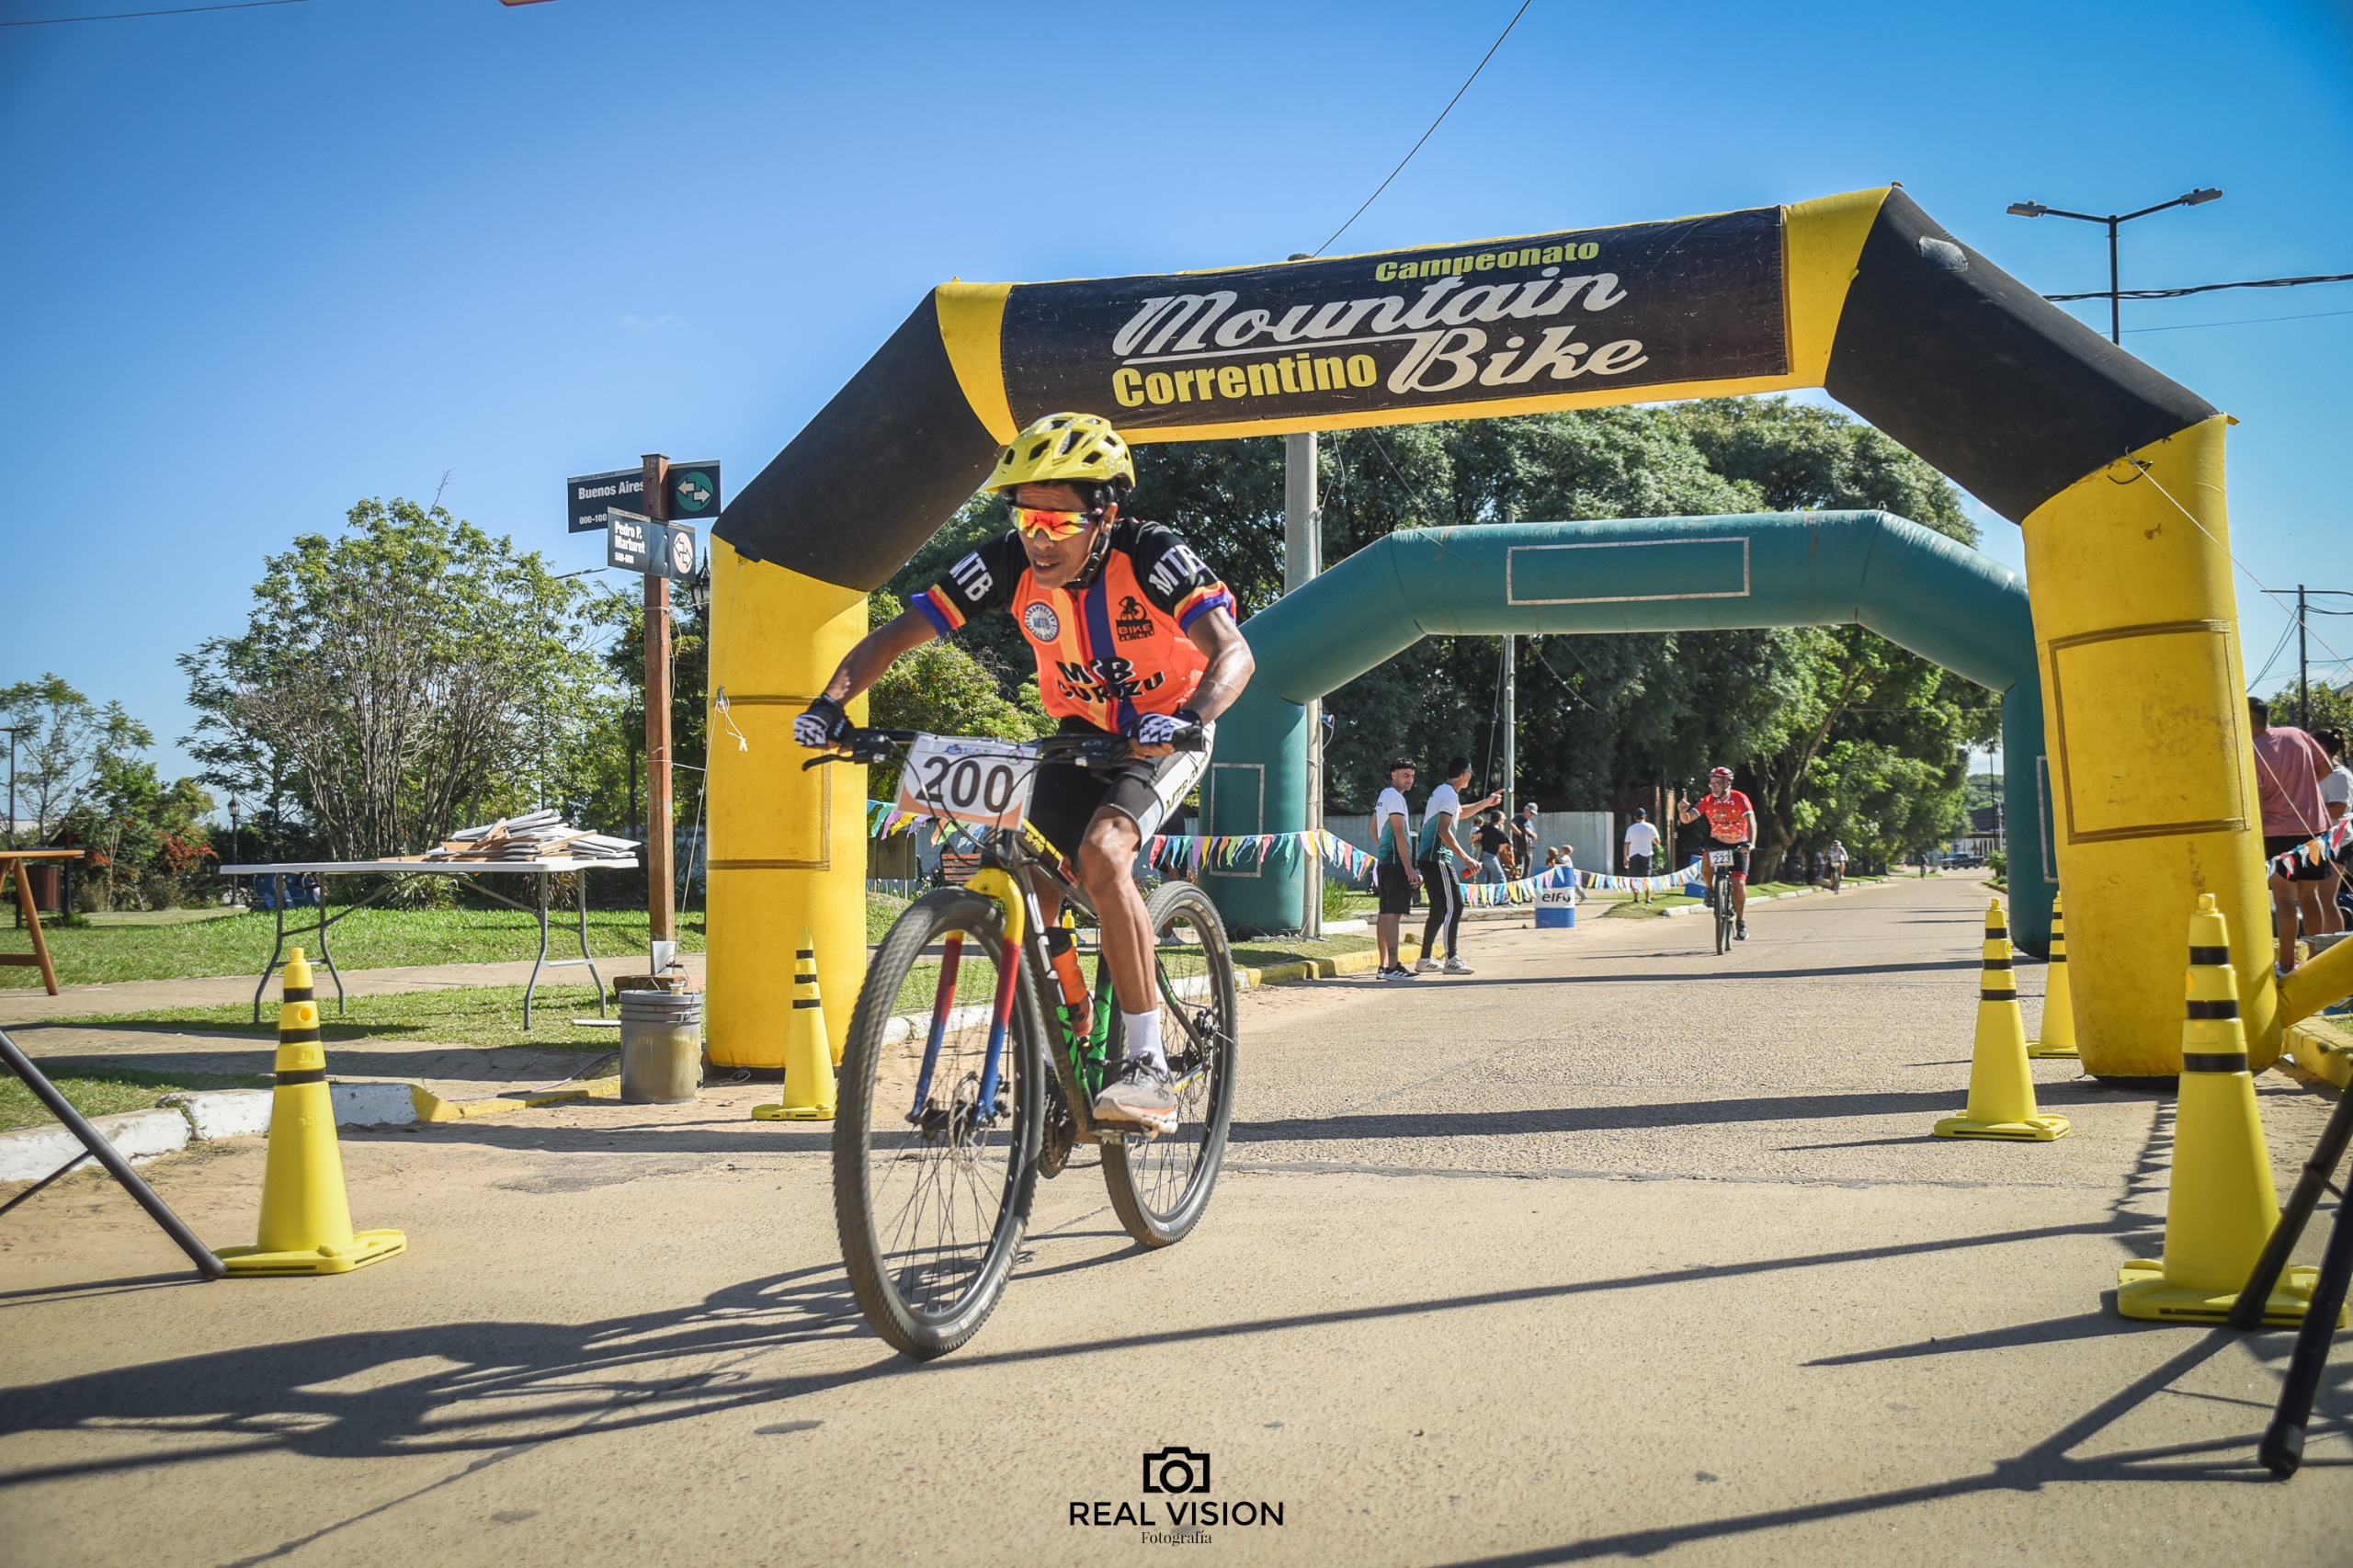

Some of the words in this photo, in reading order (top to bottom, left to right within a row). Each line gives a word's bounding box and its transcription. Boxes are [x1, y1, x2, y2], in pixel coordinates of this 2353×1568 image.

[1376, 241, 1599, 282] Campeonato
[1112, 267, 1627, 357] Mountain
[1112, 352, 1377, 407] Correntino
[1387, 325, 1649, 394] Bike
[578, 485, 617, 500] Buenos
[618, 481, 644, 494] Aires
[579, 513, 608, 525] 000-100
[614, 520, 635, 539] Pedro
[949, 551, 994, 601] MTB
[1149, 544, 1206, 597] MTB
[1118, 623, 1151, 635] BIKE
[915, 756, 1014, 812] 200
[1713, 855, 1731, 864] 223
[1541, 892, 1563, 903] elf
